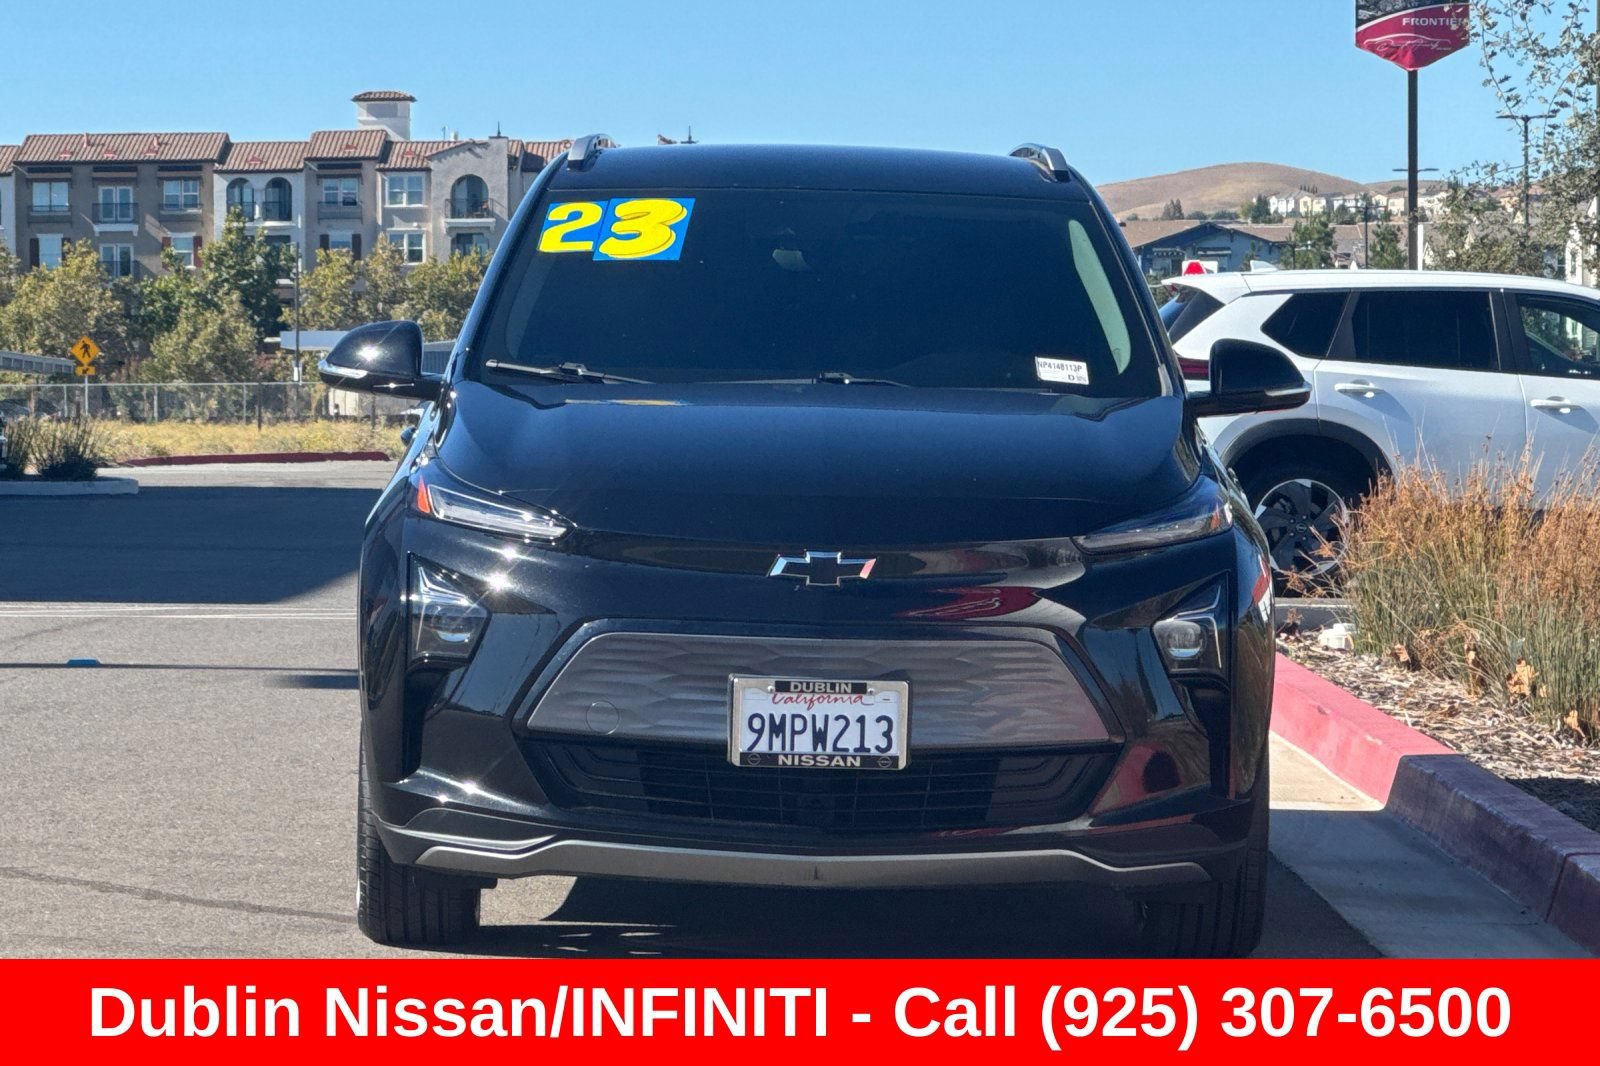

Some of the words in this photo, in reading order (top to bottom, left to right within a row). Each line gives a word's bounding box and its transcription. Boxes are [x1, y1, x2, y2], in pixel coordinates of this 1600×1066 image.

[539, 200, 687, 258] 23
[790, 682, 852, 693] DUBLIN
[772, 693, 874, 711] California
[748, 713, 894, 753] 9MPW213
[778, 755, 861, 767] NISSAN
